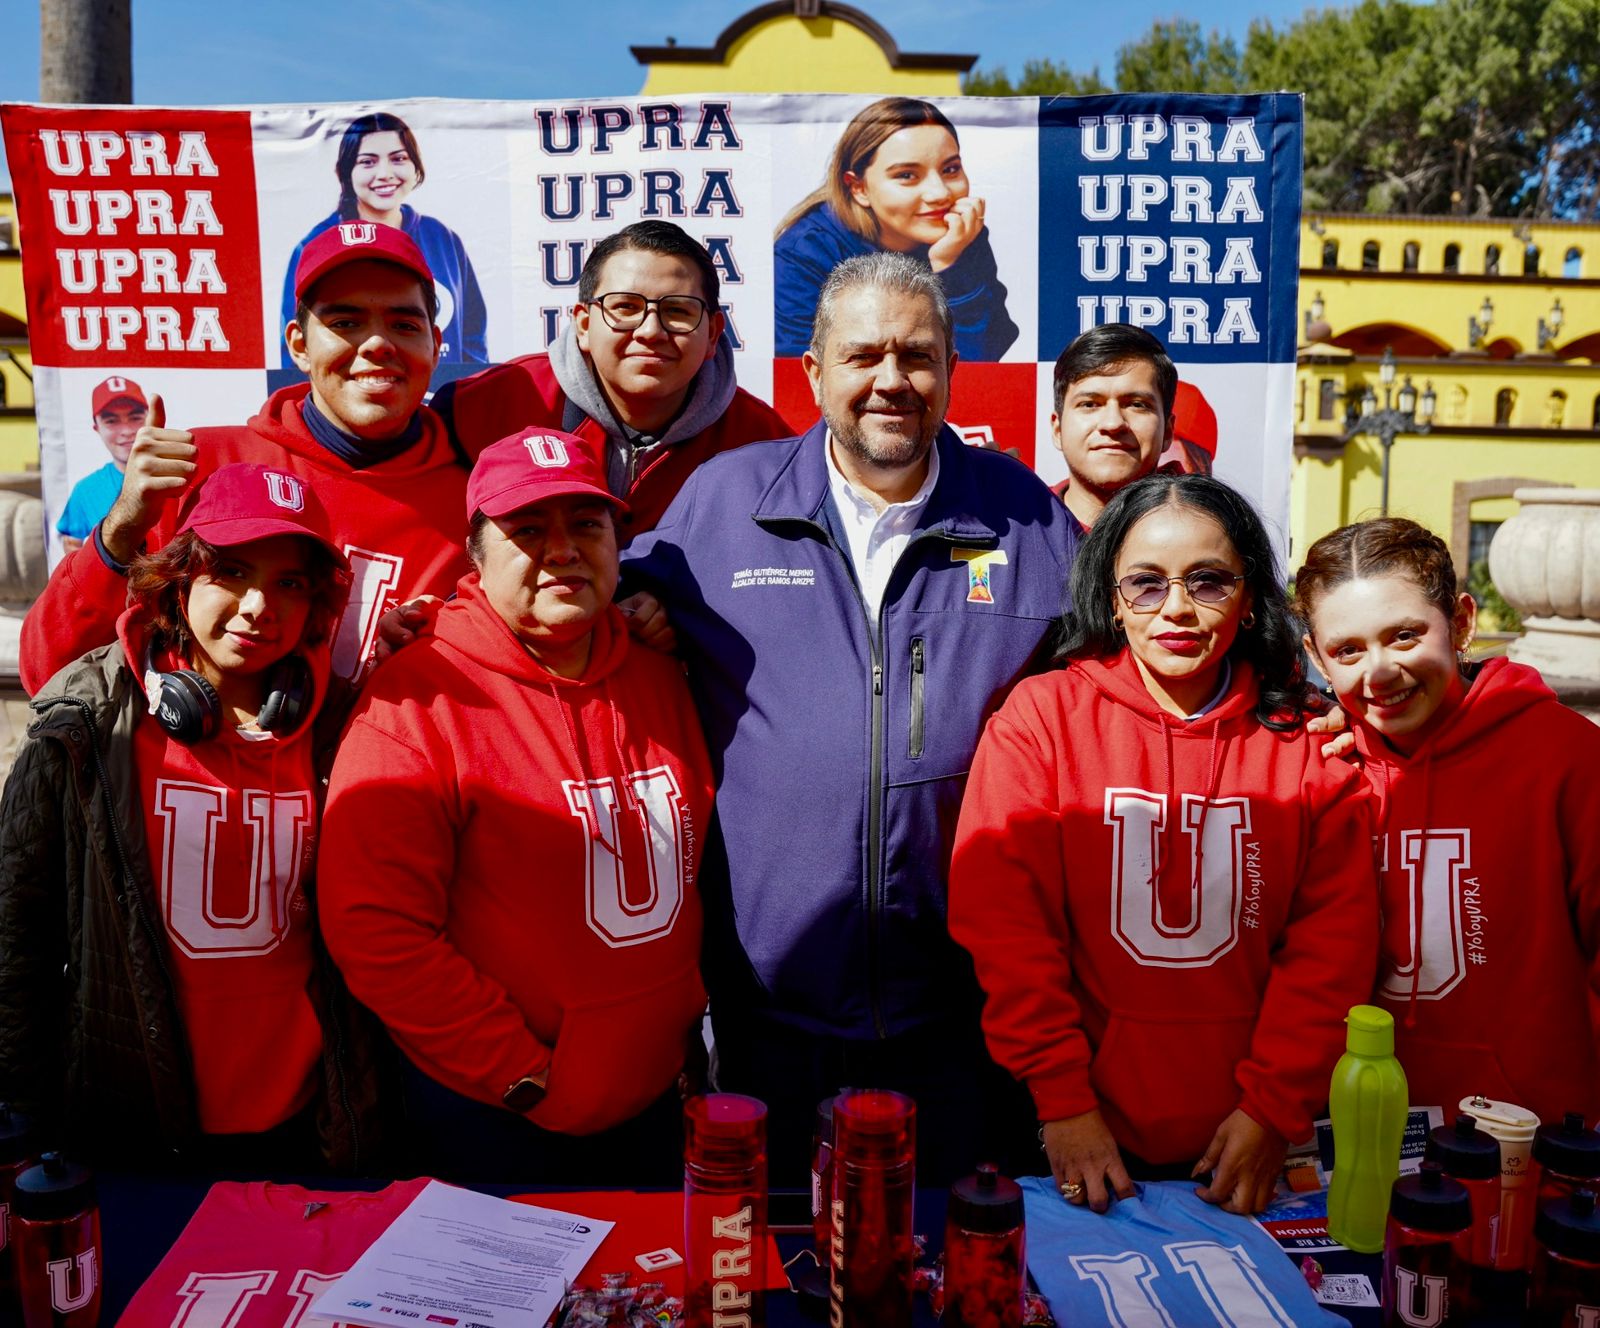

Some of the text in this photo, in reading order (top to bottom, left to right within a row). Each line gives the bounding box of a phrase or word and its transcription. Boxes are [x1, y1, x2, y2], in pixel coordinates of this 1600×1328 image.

[534, 100, 743, 156] UPRA
[1079, 114, 1265, 162] UPRA
[39, 129, 219, 177] UPRA
[49, 189, 223, 237] UPRA
[537, 168, 744, 222] UPRA
[1078, 174, 1264, 223] UPRA
[338, 223, 377, 247] U
[1078, 235, 1262, 284] UPRA
[56, 249, 227, 294] UPRA
[538, 235, 744, 288] UA
[61, 307, 230, 352] UPRA
[523, 436, 570, 468] U
[263, 471, 304, 513] U
[731, 578, 756, 588] ALCALDE
[767, 577, 790, 585] RAMOS
[733, 567, 814, 580] TOMÁS GUTIÉRREZ MERINO
[561, 765, 682, 949] U
[680, 803, 695, 885] #YoSoyUPRA
[154, 778, 311, 960] U
[1103, 787, 1253, 969] U
[1242, 842, 1266, 929] #YoSoyUPRA
[1463, 877, 1488, 965] #YoSoyUPRA
[46, 1246, 97, 1314] U
[1395, 1264, 1448, 1328] U
